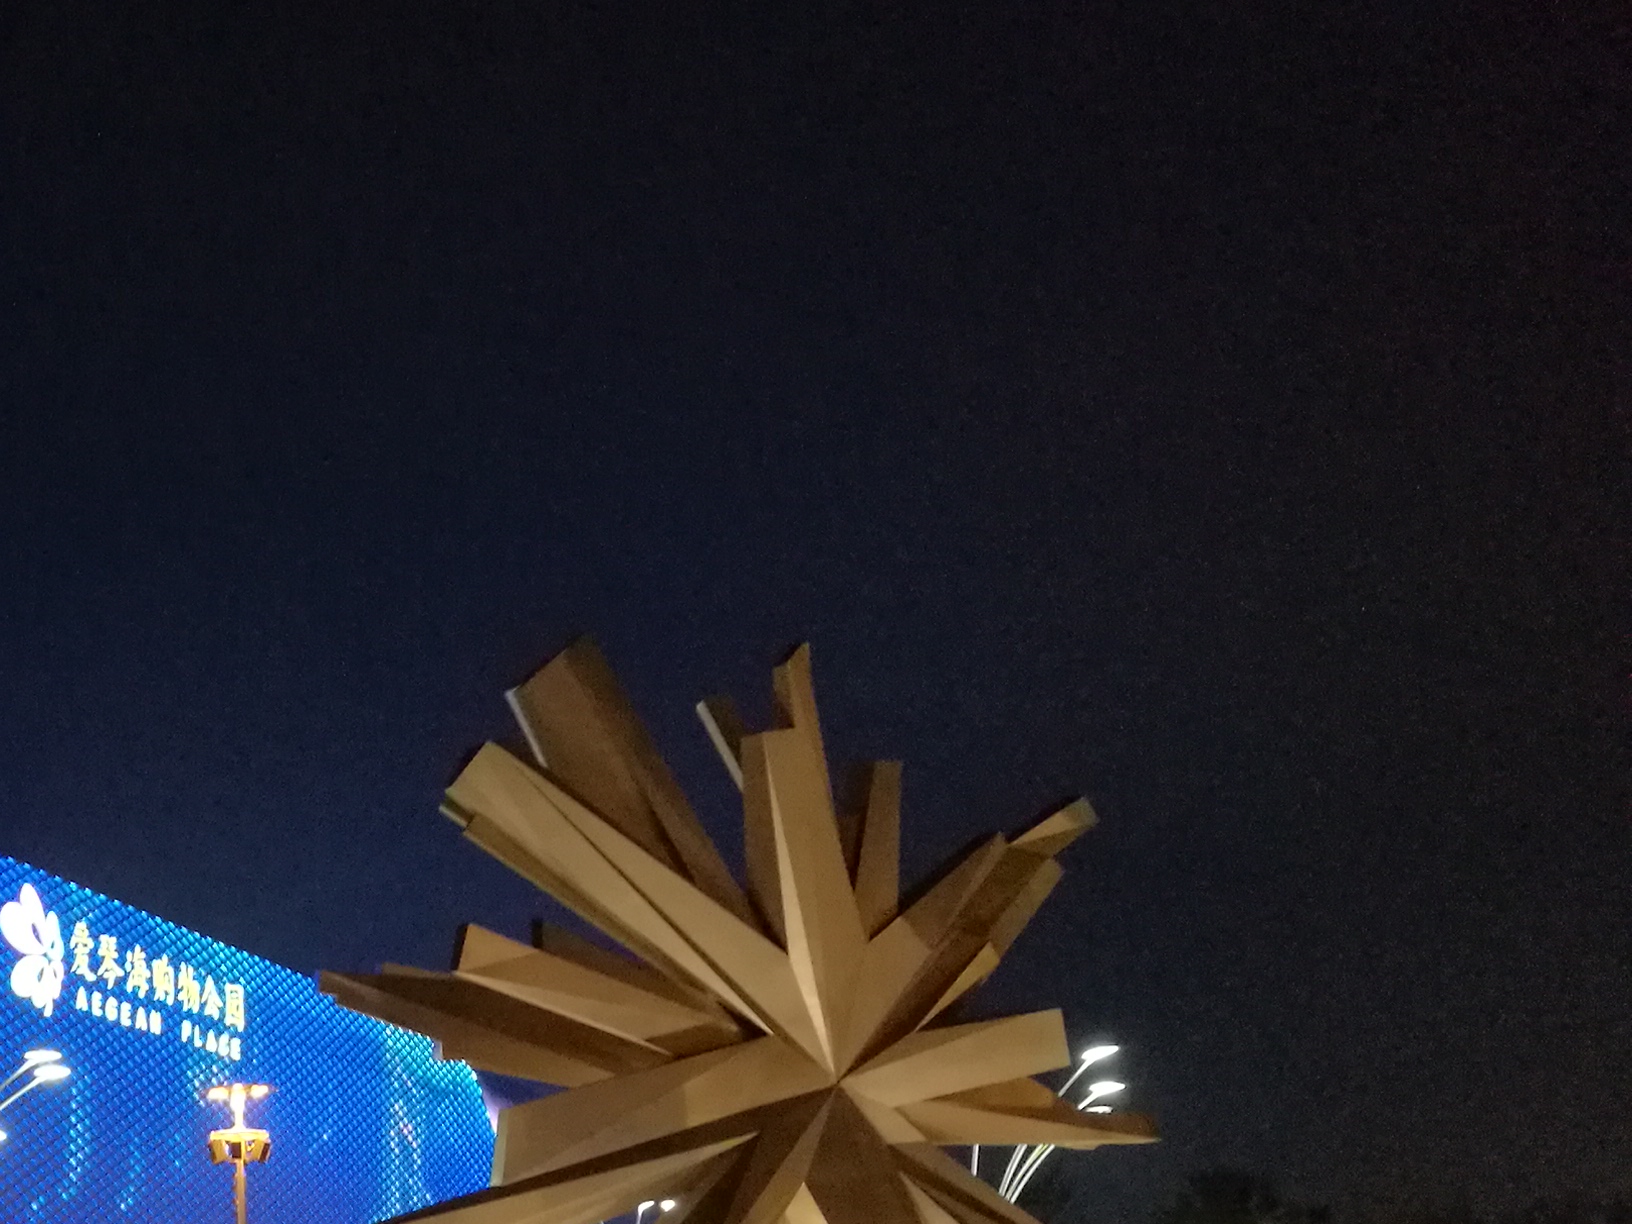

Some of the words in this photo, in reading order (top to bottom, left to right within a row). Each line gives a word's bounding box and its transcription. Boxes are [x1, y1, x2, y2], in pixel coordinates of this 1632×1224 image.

[70, 920, 245, 1032] 爱琴海购物公园
[75, 986, 162, 1035] AEGEAN
[181, 1020, 241, 1061] PLACE
